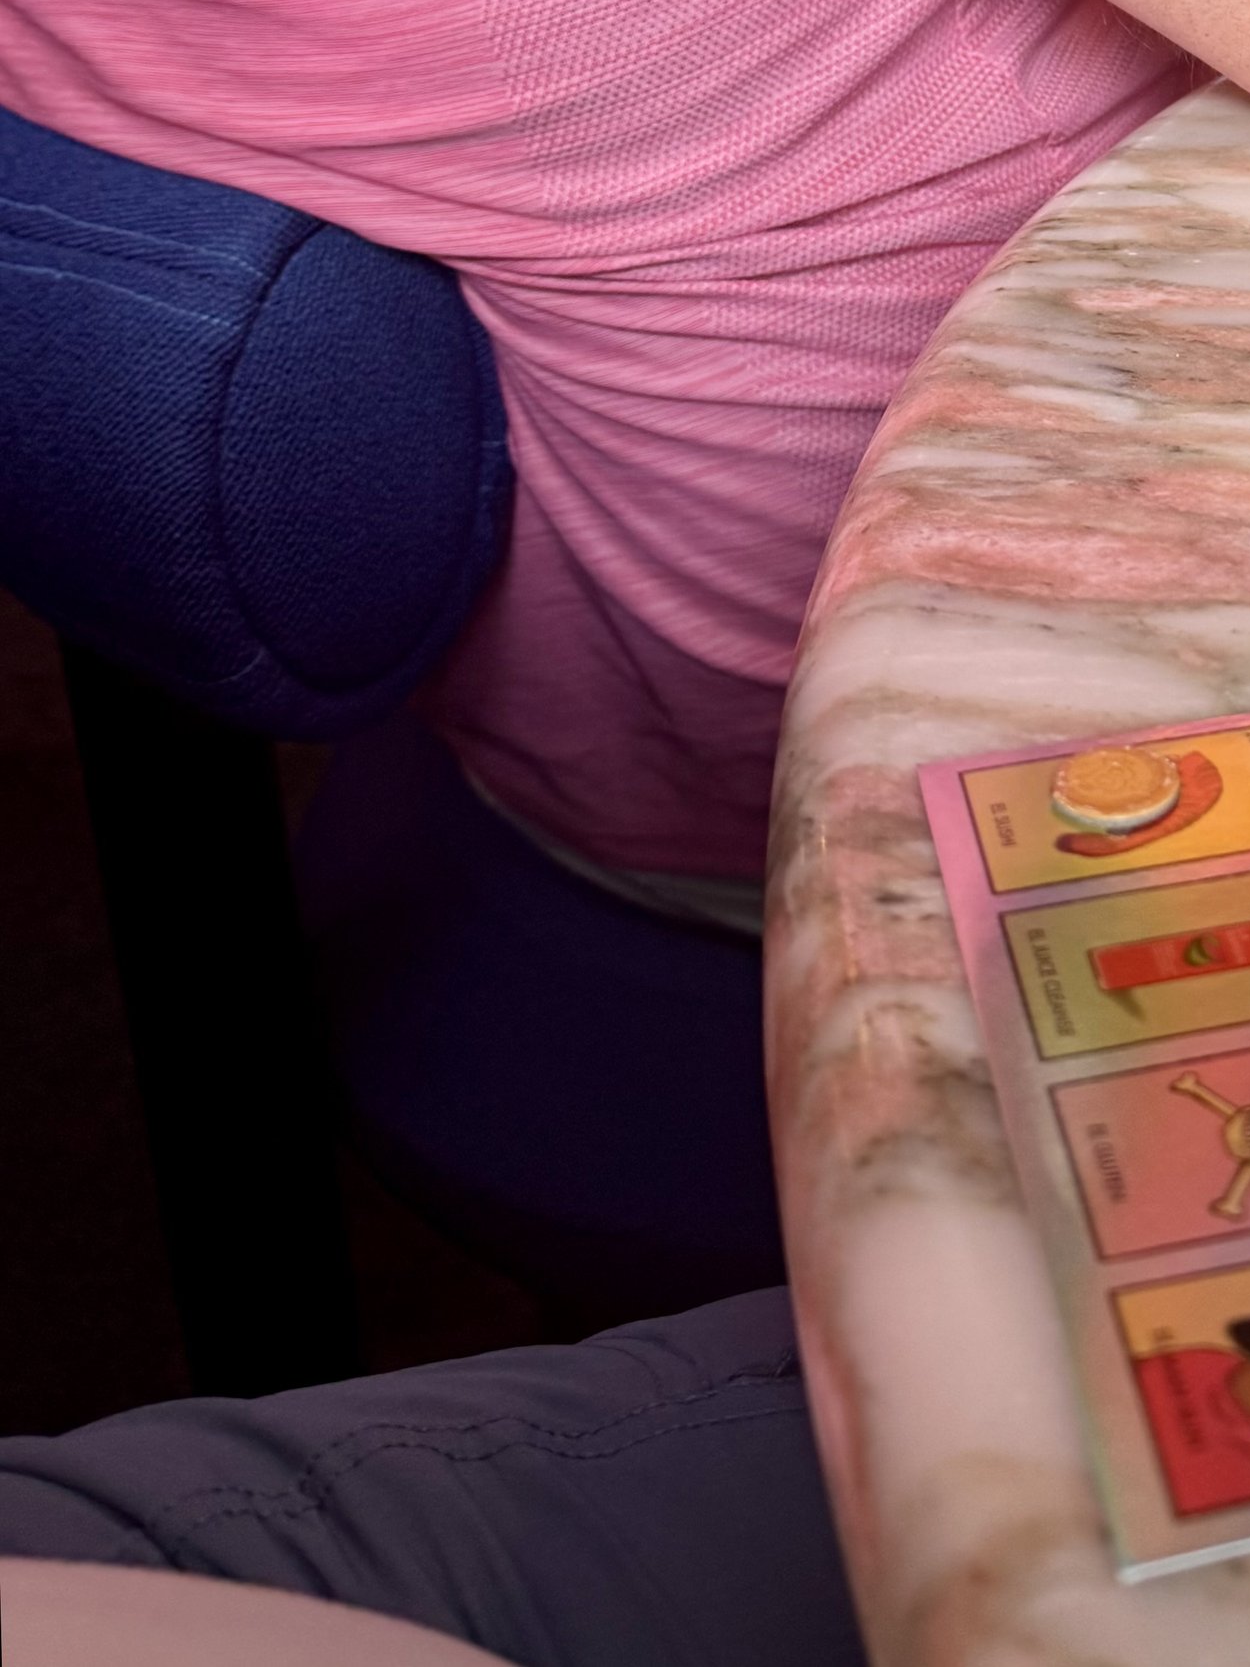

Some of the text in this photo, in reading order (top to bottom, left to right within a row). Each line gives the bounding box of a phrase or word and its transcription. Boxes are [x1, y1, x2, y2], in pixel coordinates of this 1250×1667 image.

[990, 802, 1017, 846] EL SUSHI
[1025, 927, 1077, 1038] EL JUICE CLEANSE
